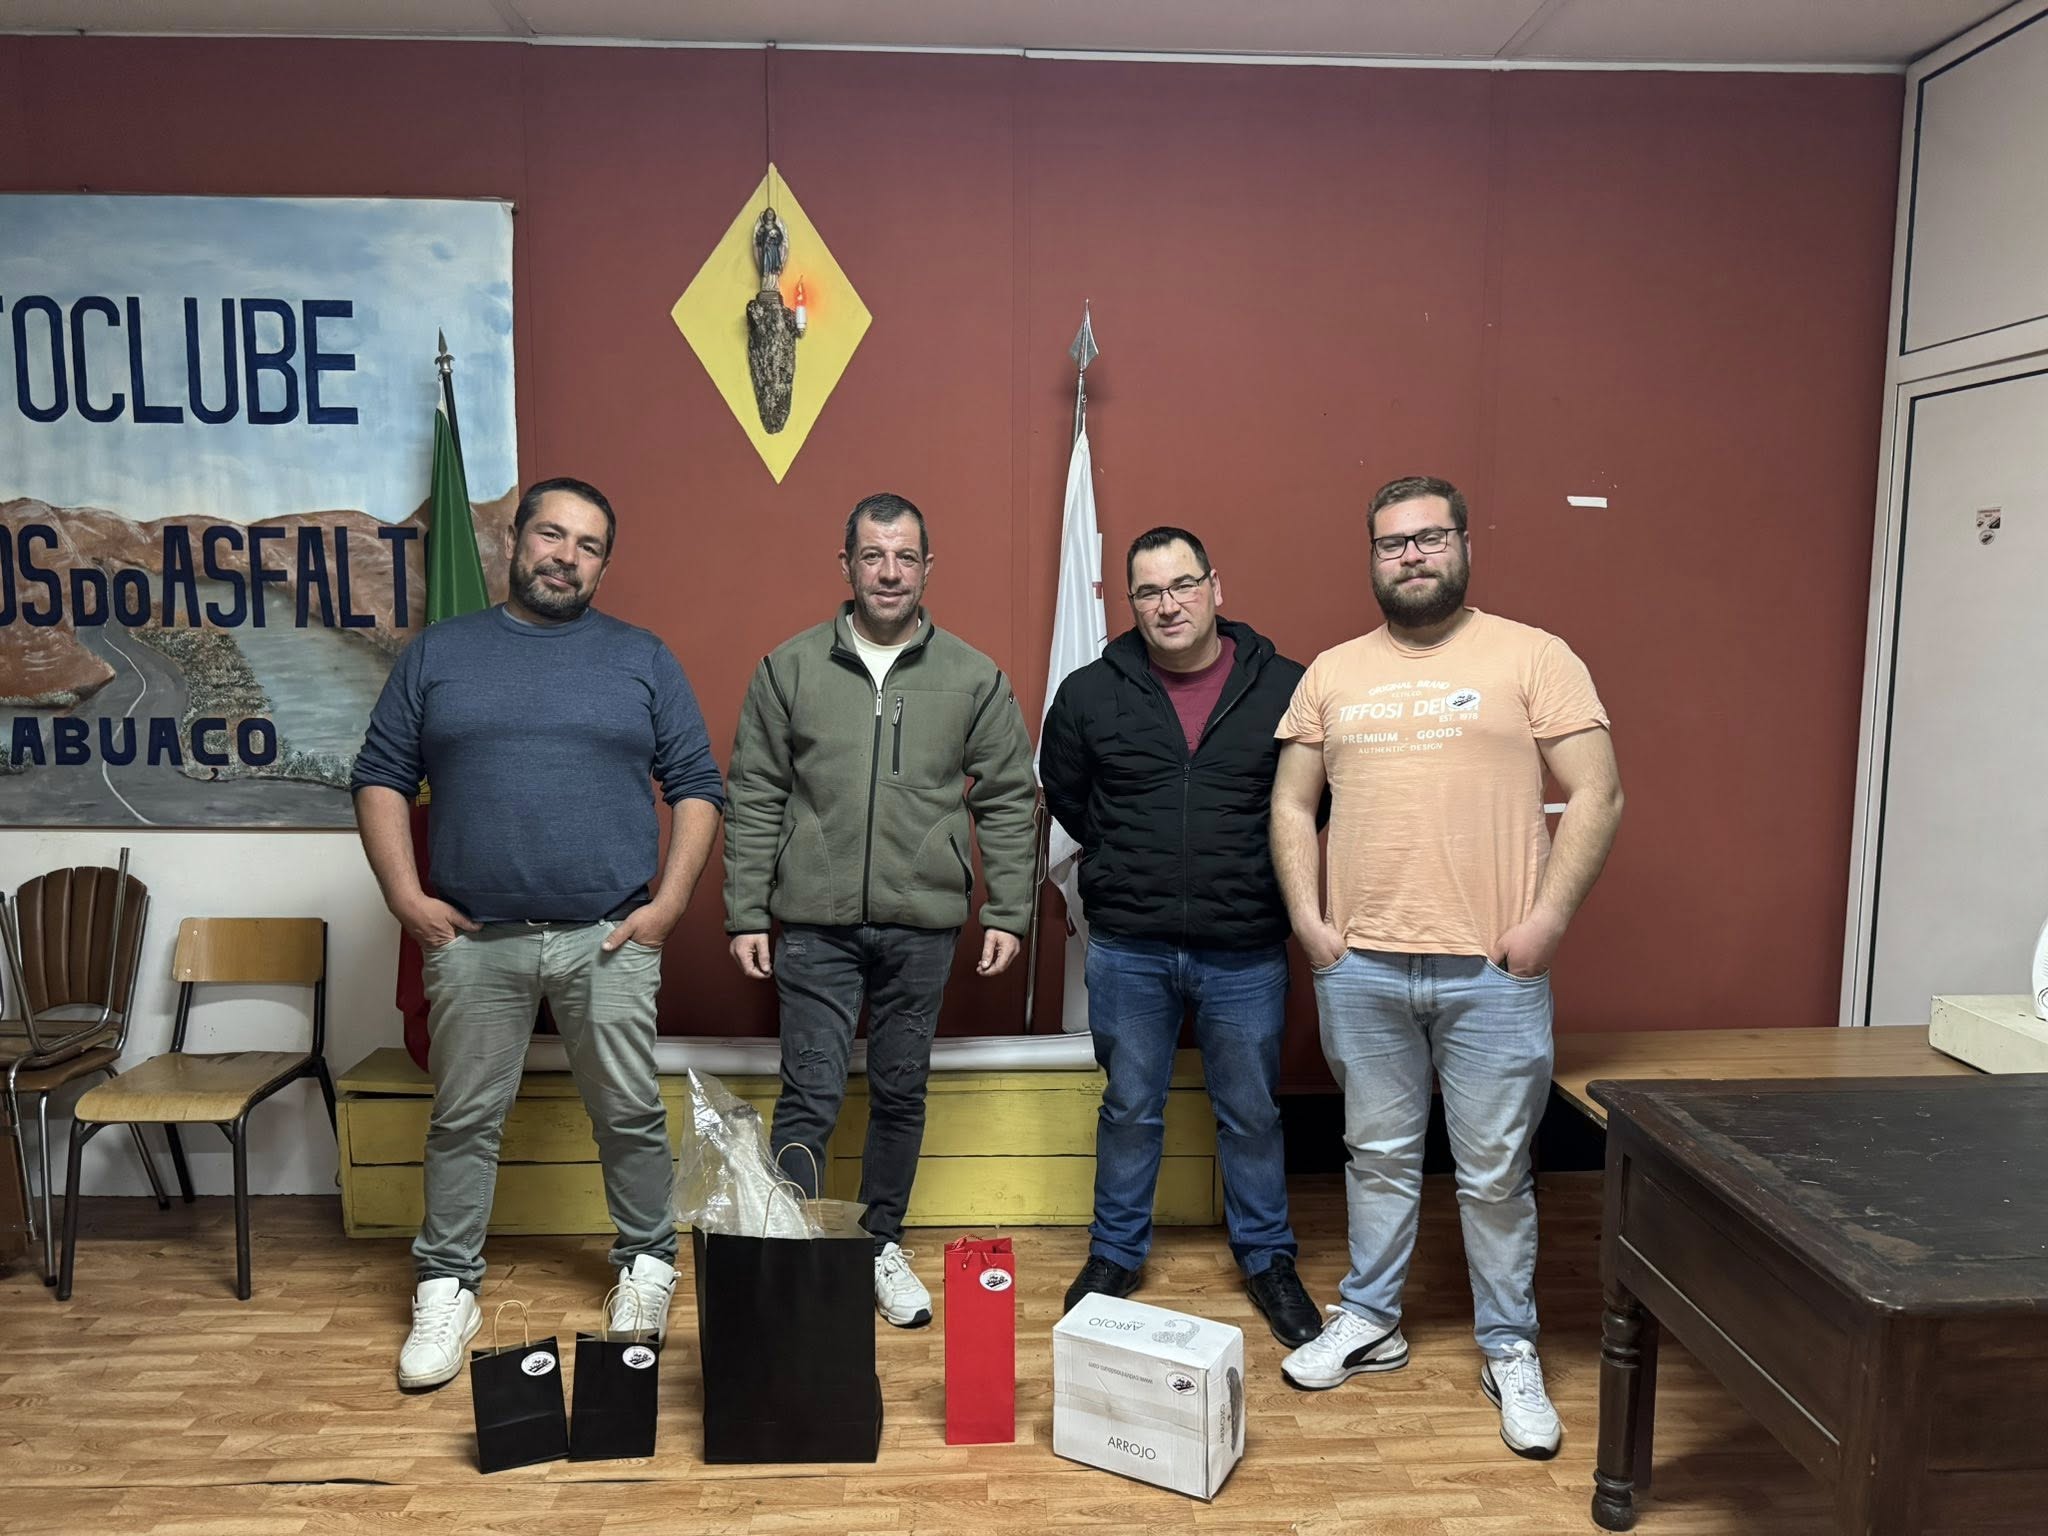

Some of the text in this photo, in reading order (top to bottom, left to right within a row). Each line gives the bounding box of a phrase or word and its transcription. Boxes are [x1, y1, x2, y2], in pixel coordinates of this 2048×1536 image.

[0, 295, 359, 424] OCLUBE
[70, 568, 151, 627] DO
[161, 526, 432, 628] ASFALT
[1368, 681, 1412, 696] ORIGINAL
[1416, 679, 1451, 691] BRAND
[1338, 702, 1404, 723] TIFFOSI
[1342, 726, 1463, 745] PREMIUM GOODS
[1358, 742, 1444, 754] AUTHENTIC DESIGN
[1088, 1317, 1145, 1333] ARROJO
[1107, 1435, 1157, 1460] ARROJO
